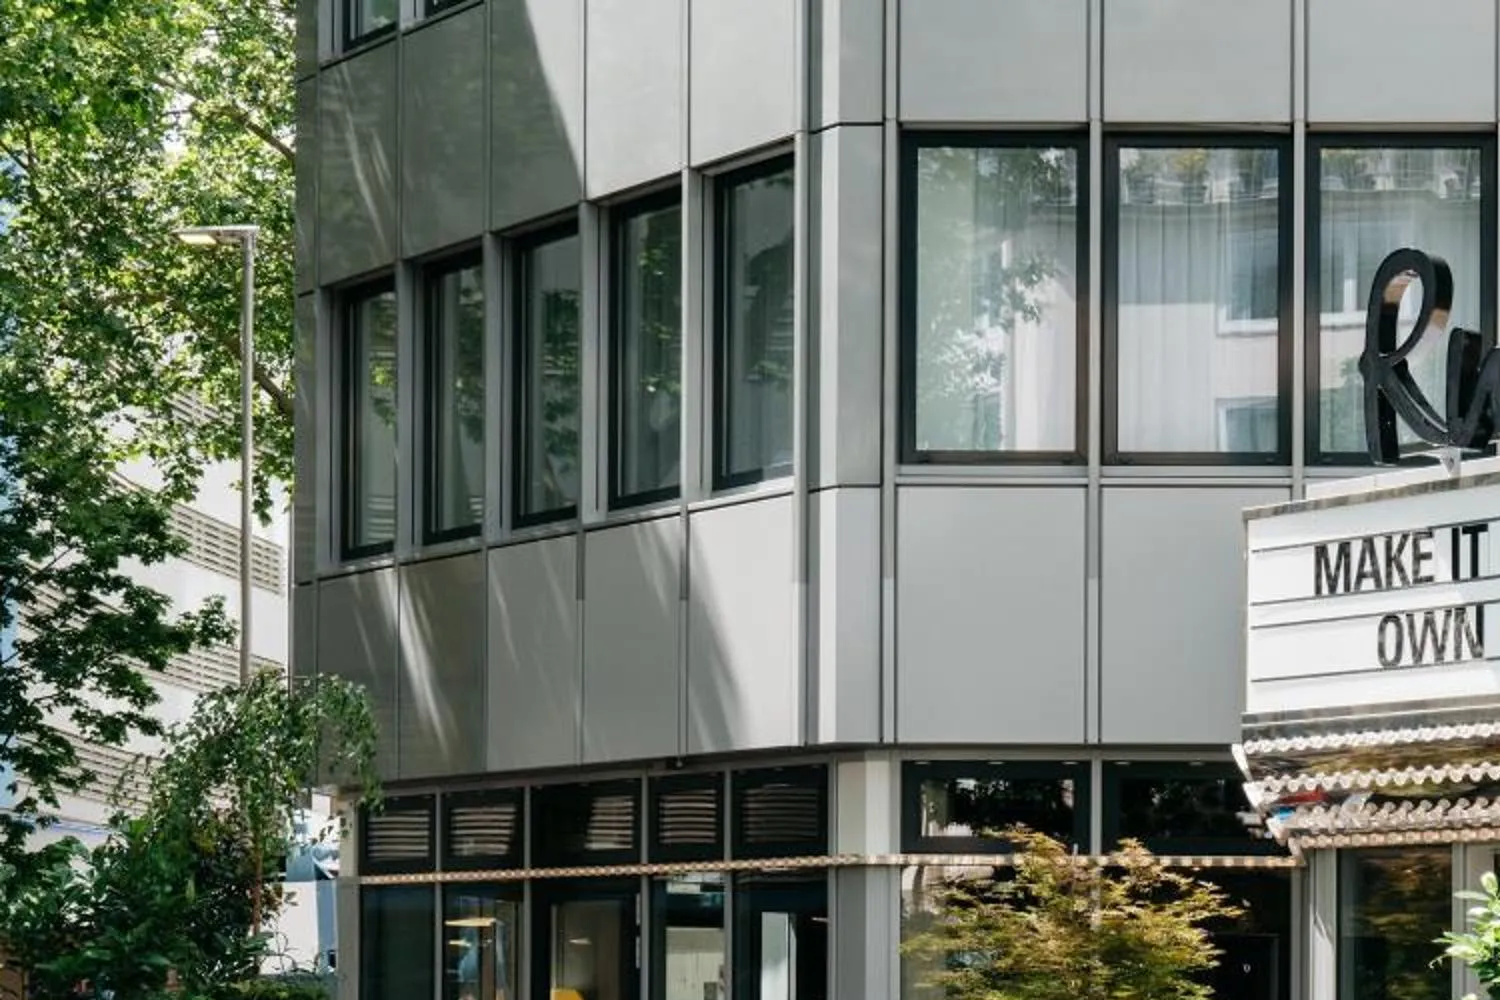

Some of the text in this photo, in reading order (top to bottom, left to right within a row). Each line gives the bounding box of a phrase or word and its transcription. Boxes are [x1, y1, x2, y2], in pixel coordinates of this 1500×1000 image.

[1314, 530, 1435, 596] MAKE
[1451, 523, 1489, 581] IT
[1377, 603, 1485, 669] OWN
